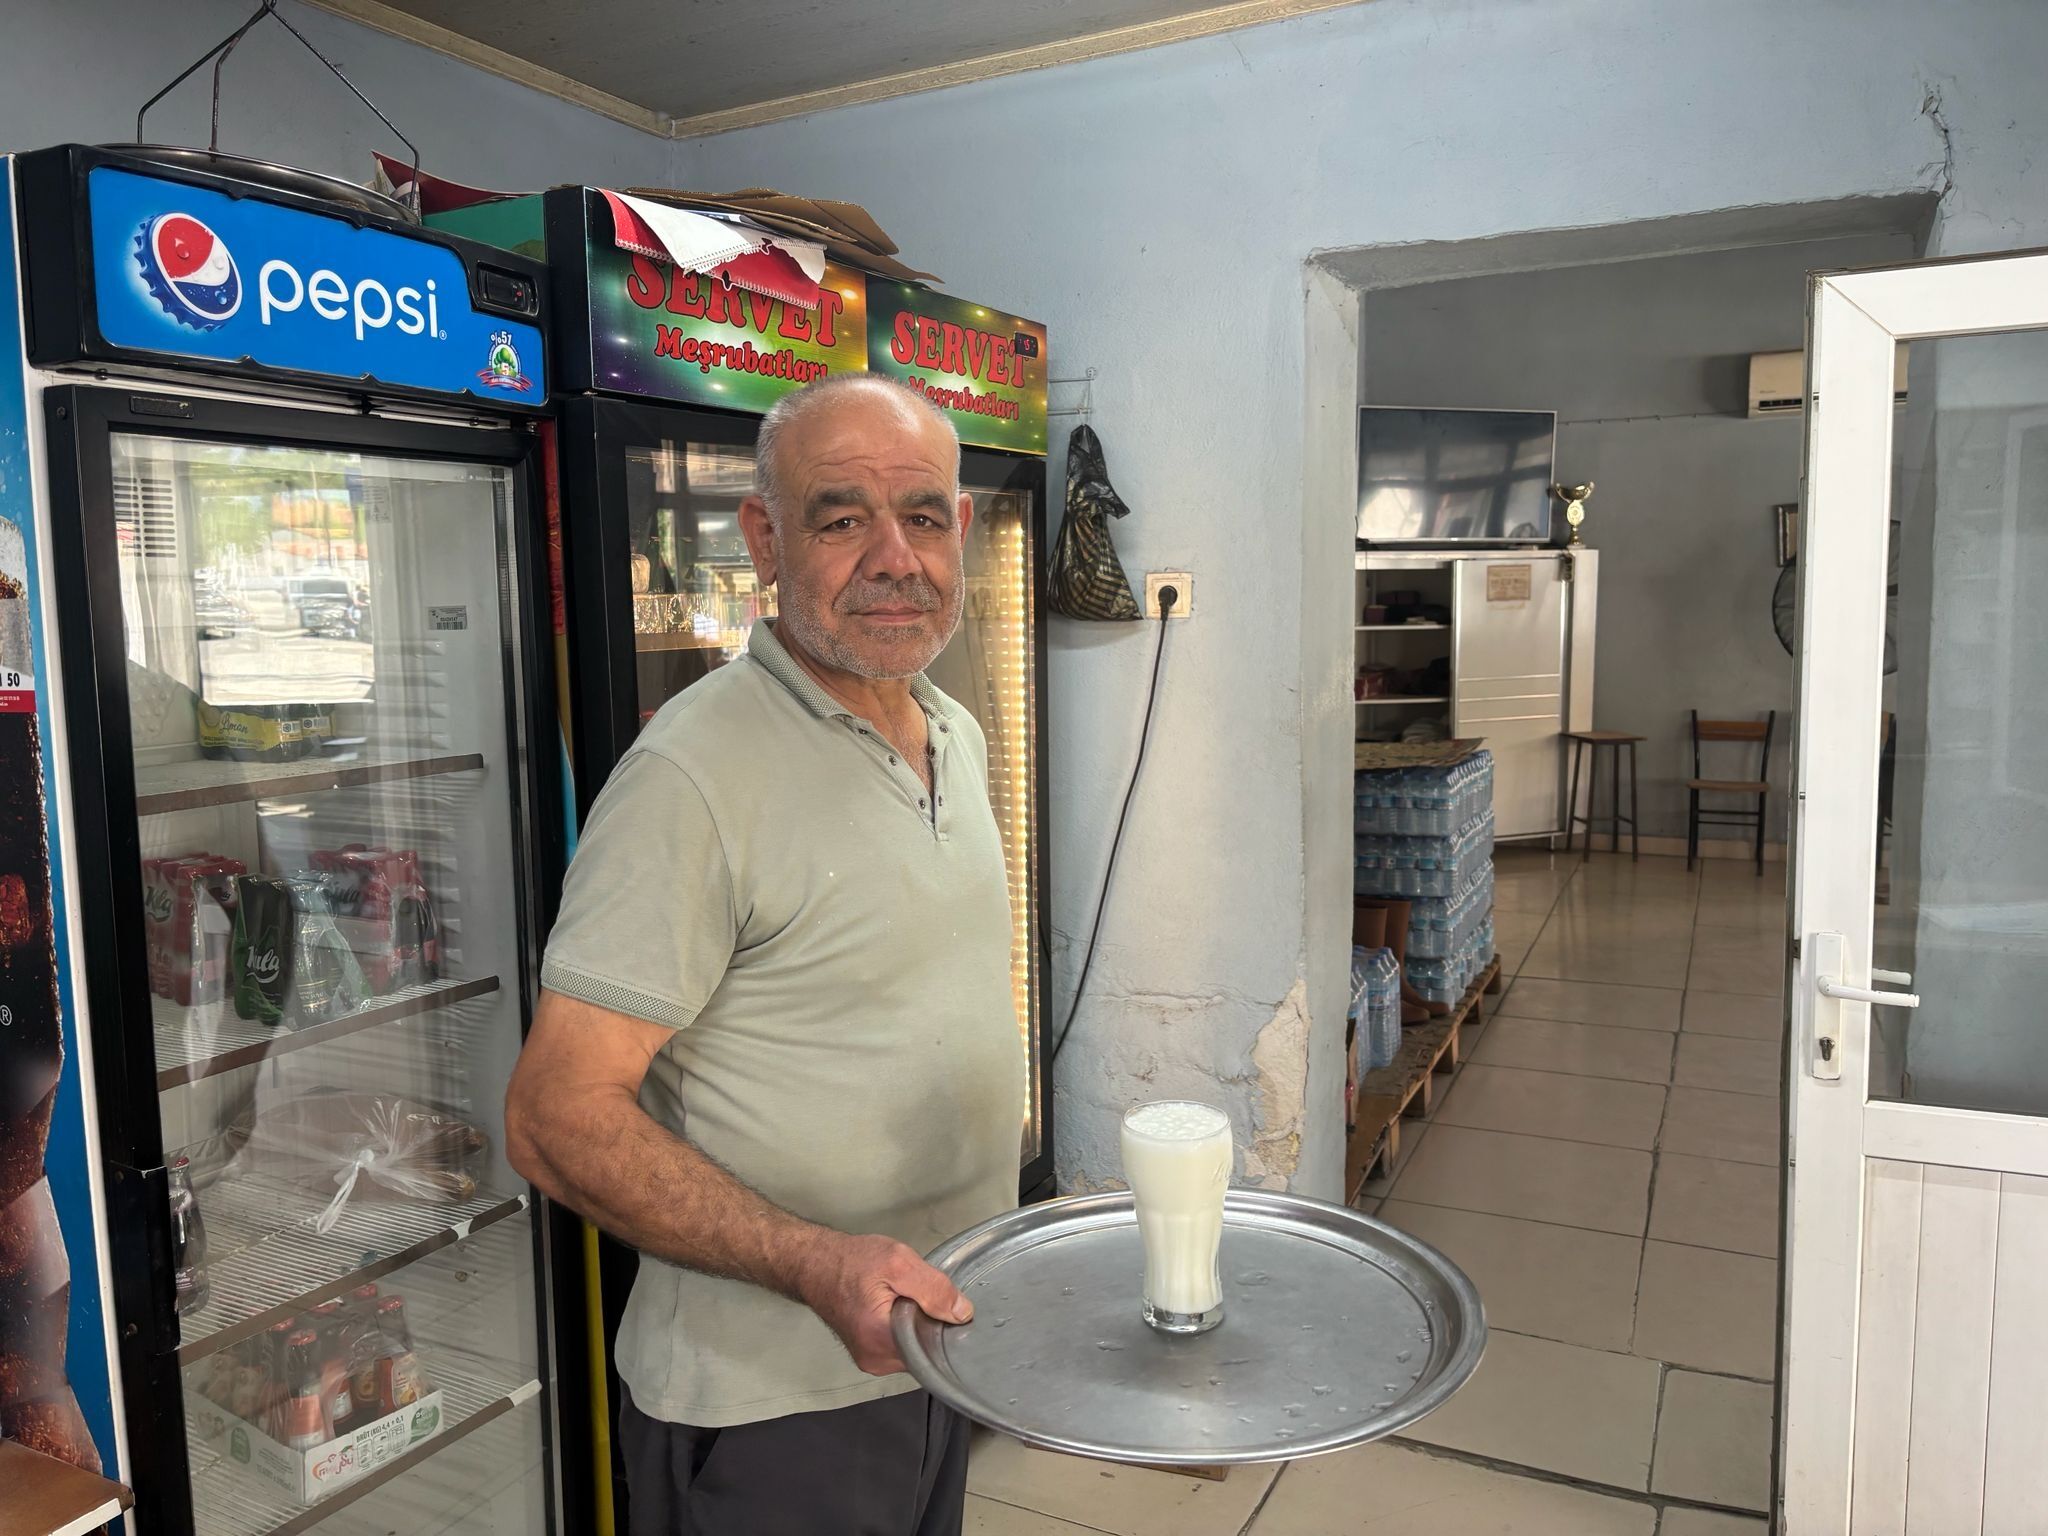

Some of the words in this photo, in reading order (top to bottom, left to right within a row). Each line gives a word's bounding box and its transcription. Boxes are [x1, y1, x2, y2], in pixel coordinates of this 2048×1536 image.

[259, 259, 438, 341] pepsi
[654, 324, 829, 384] Meşrubatları
[7, 672, 20, 687] 50
